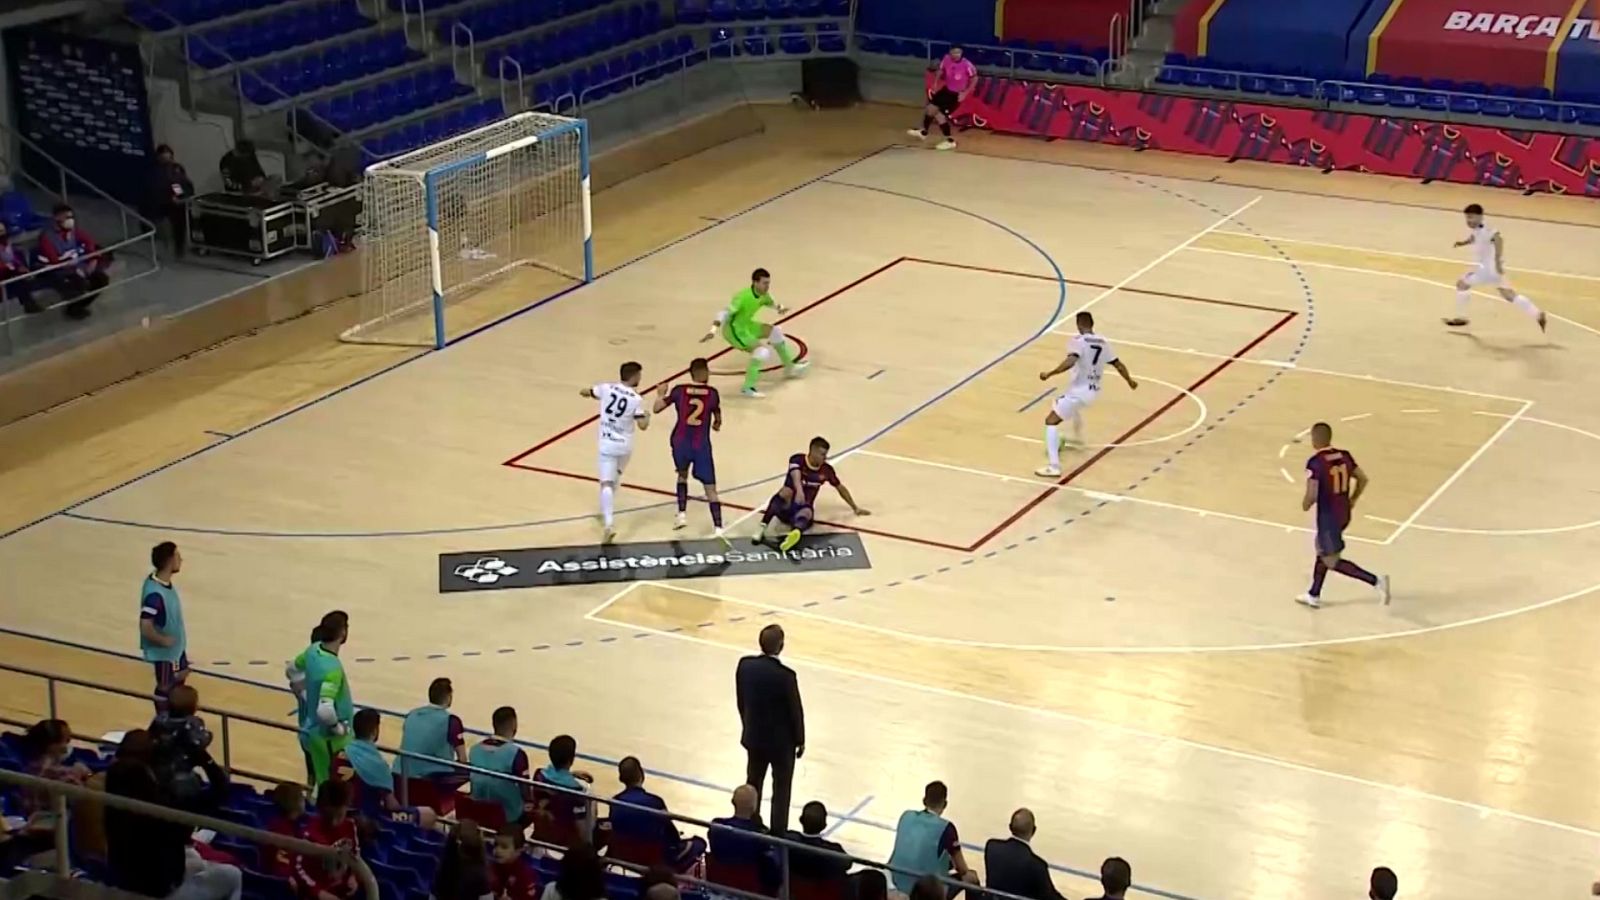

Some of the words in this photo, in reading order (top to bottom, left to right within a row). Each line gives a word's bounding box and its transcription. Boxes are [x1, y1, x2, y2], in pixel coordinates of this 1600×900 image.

[1444, 11, 1562, 39] BARÇA
[1090, 344, 1103, 366] 7
[605, 392, 628, 418] 29
[687, 398, 705, 426] 2
[1329, 463, 1349, 495] 11
